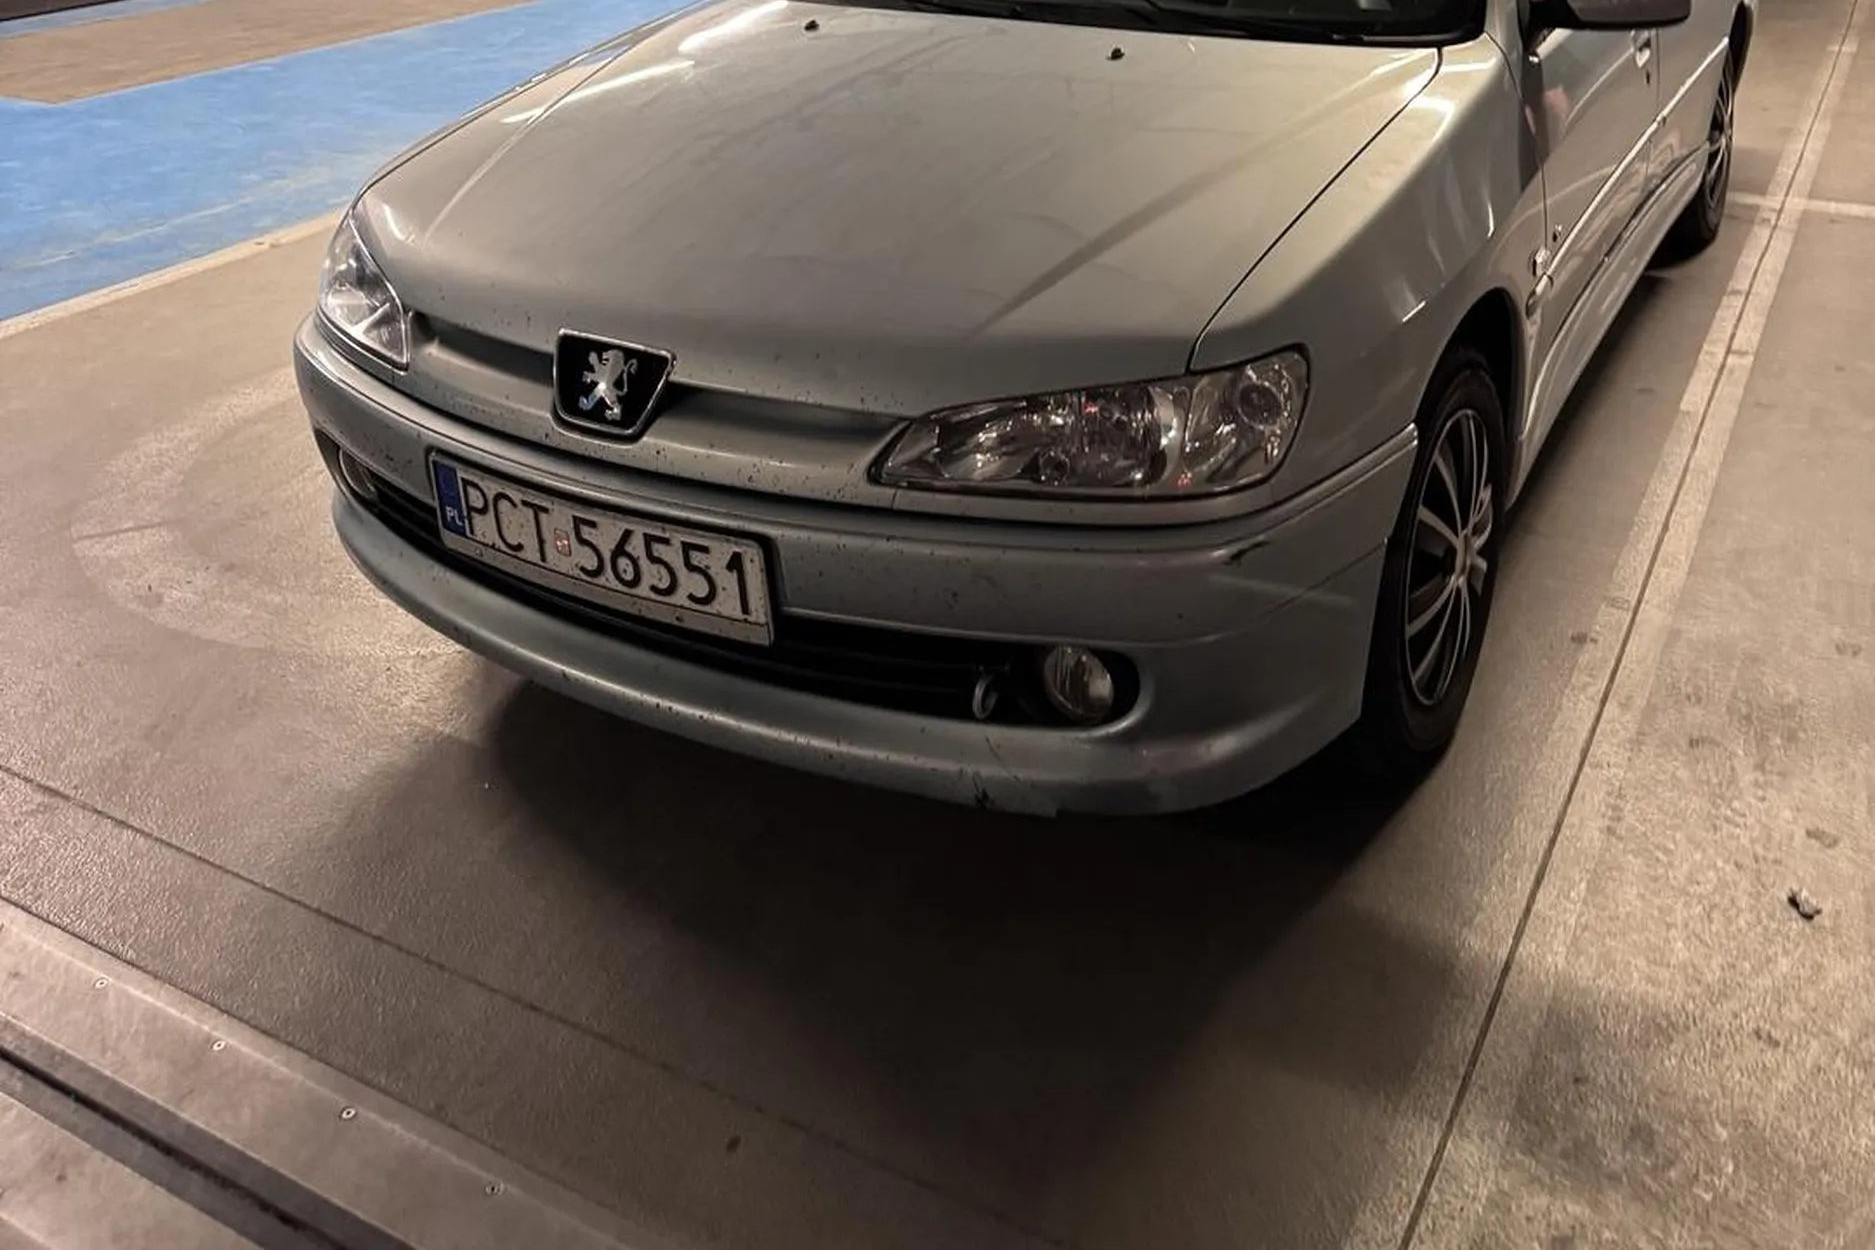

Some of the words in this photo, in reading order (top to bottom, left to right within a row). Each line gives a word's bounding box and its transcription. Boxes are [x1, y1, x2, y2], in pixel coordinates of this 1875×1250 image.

[446, 507, 464, 526] PL
[462, 477, 549, 563] PCT
[572, 514, 750, 615] 56551
